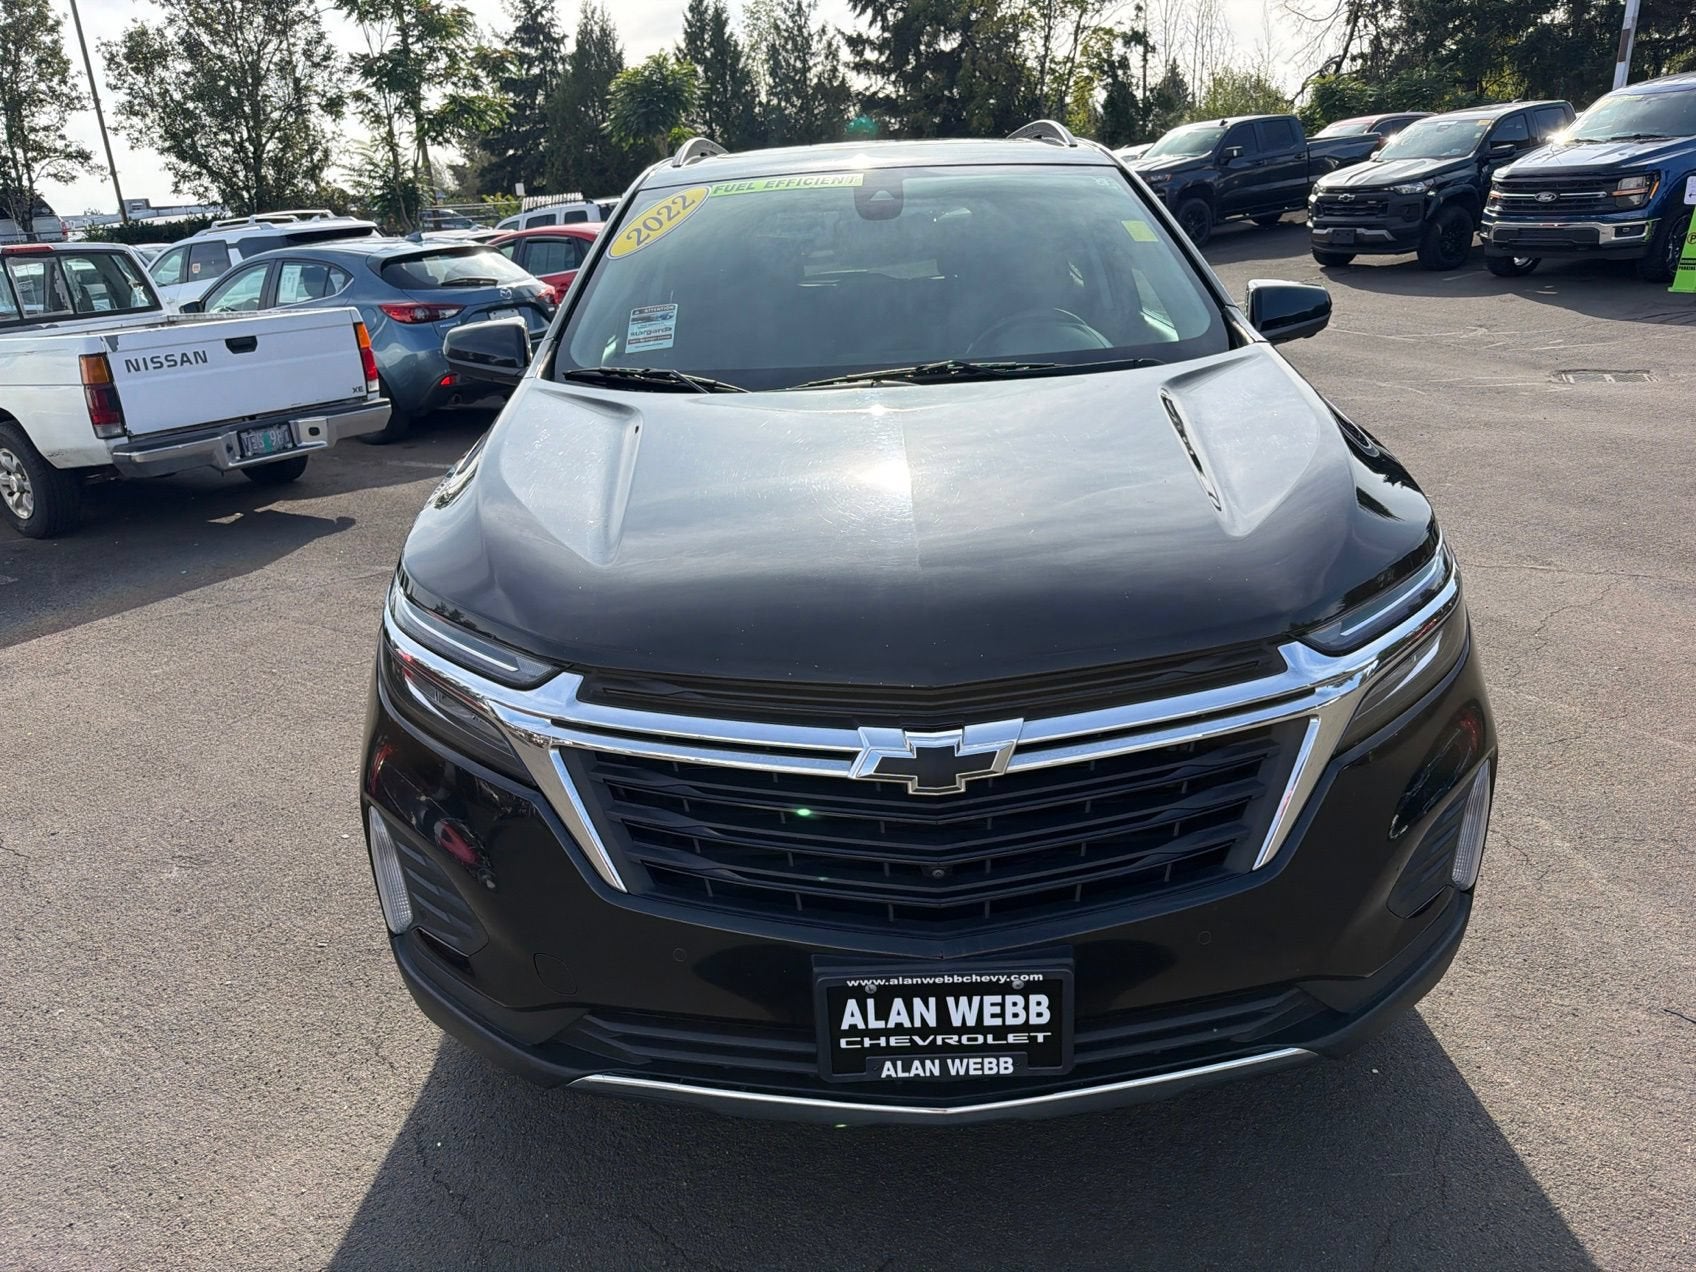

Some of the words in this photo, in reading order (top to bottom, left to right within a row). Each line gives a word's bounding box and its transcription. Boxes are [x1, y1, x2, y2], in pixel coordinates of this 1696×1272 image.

[713, 183, 755, 194] FUEL
[763, 177, 857, 189] EFFICIENT
[626, 194, 696, 247] 2022
[124, 350, 209, 374] NISSAN
[846, 973, 1043, 987] www.alanwebbchevy.com
[840, 997, 937, 1030] ALAN
[946, 994, 1051, 1027] WEBB
[839, 1032, 1052, 1048] CHEVROLET
[881, 1059, 941, 1078] ALAN
[946, 1057, 1014, 1076] WEBB
